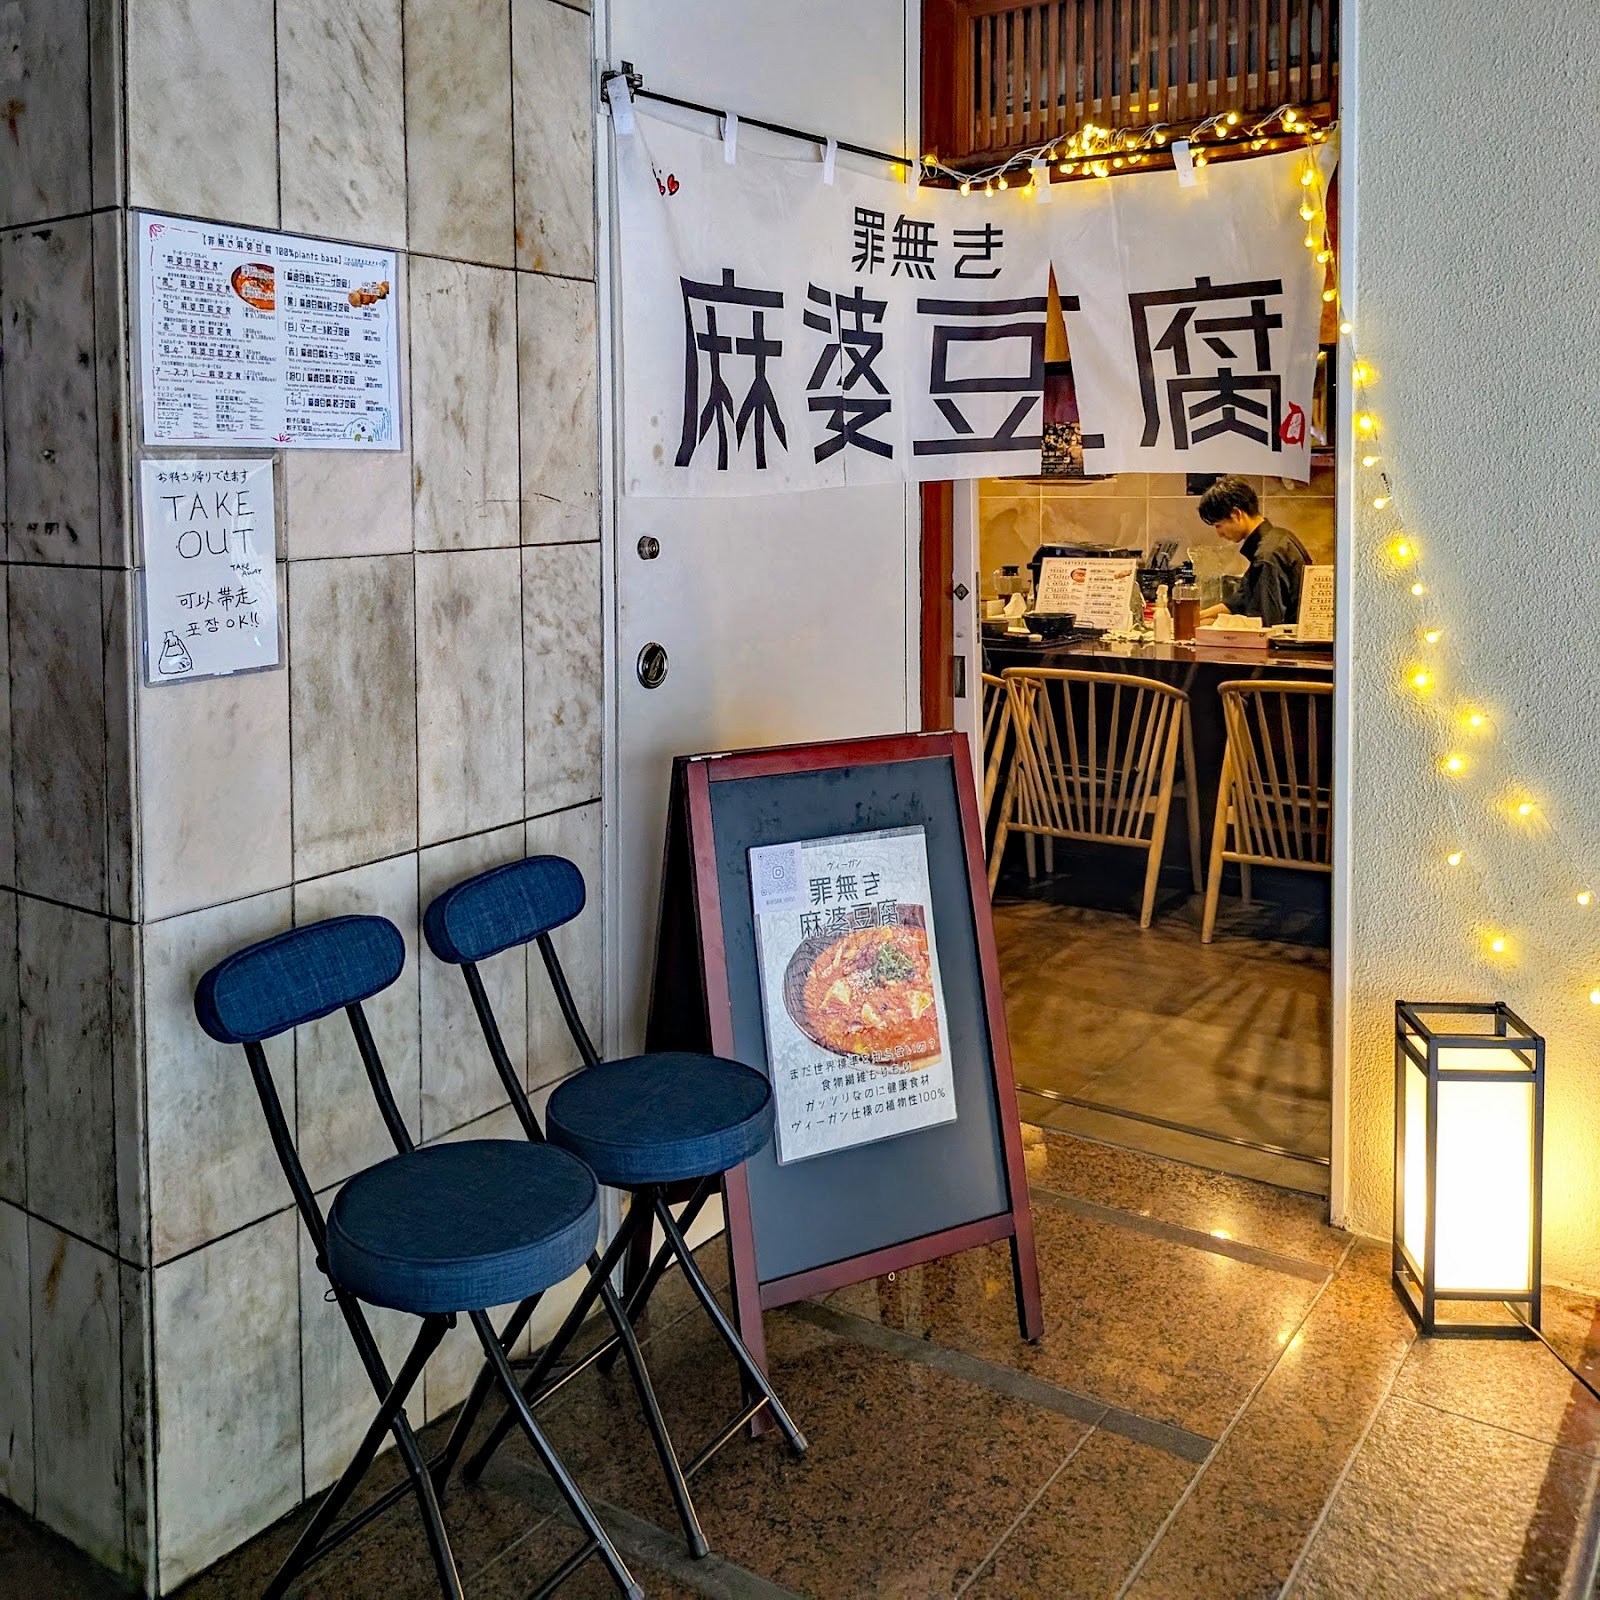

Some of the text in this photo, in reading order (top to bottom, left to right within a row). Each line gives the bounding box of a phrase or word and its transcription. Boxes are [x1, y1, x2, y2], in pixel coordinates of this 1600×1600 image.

[852, 206, 1004, 280] 罪無き
[675, 268, 1284, 470] 麻婆豆腐
[160, 491, 254, 522] TAKE
[177, 528, 254, 558] OUT
[230, 563, 250, 572] TAKE
[186, 612, 260, 638] 포장 OK!!
[827, 859, 861, 870] ヴィーガン
[809, 872, 881, 905] 罪無き
[800, 899, 899, 939] 麻婆豆腐
[822, 1061, 912, 1091] 食物繊維もりもり
[806, 1074, 930, 1112] ガッツリなのに健康食材
[792, 1088, 946, 1133] ヴィーガン仕様の植物性100%
